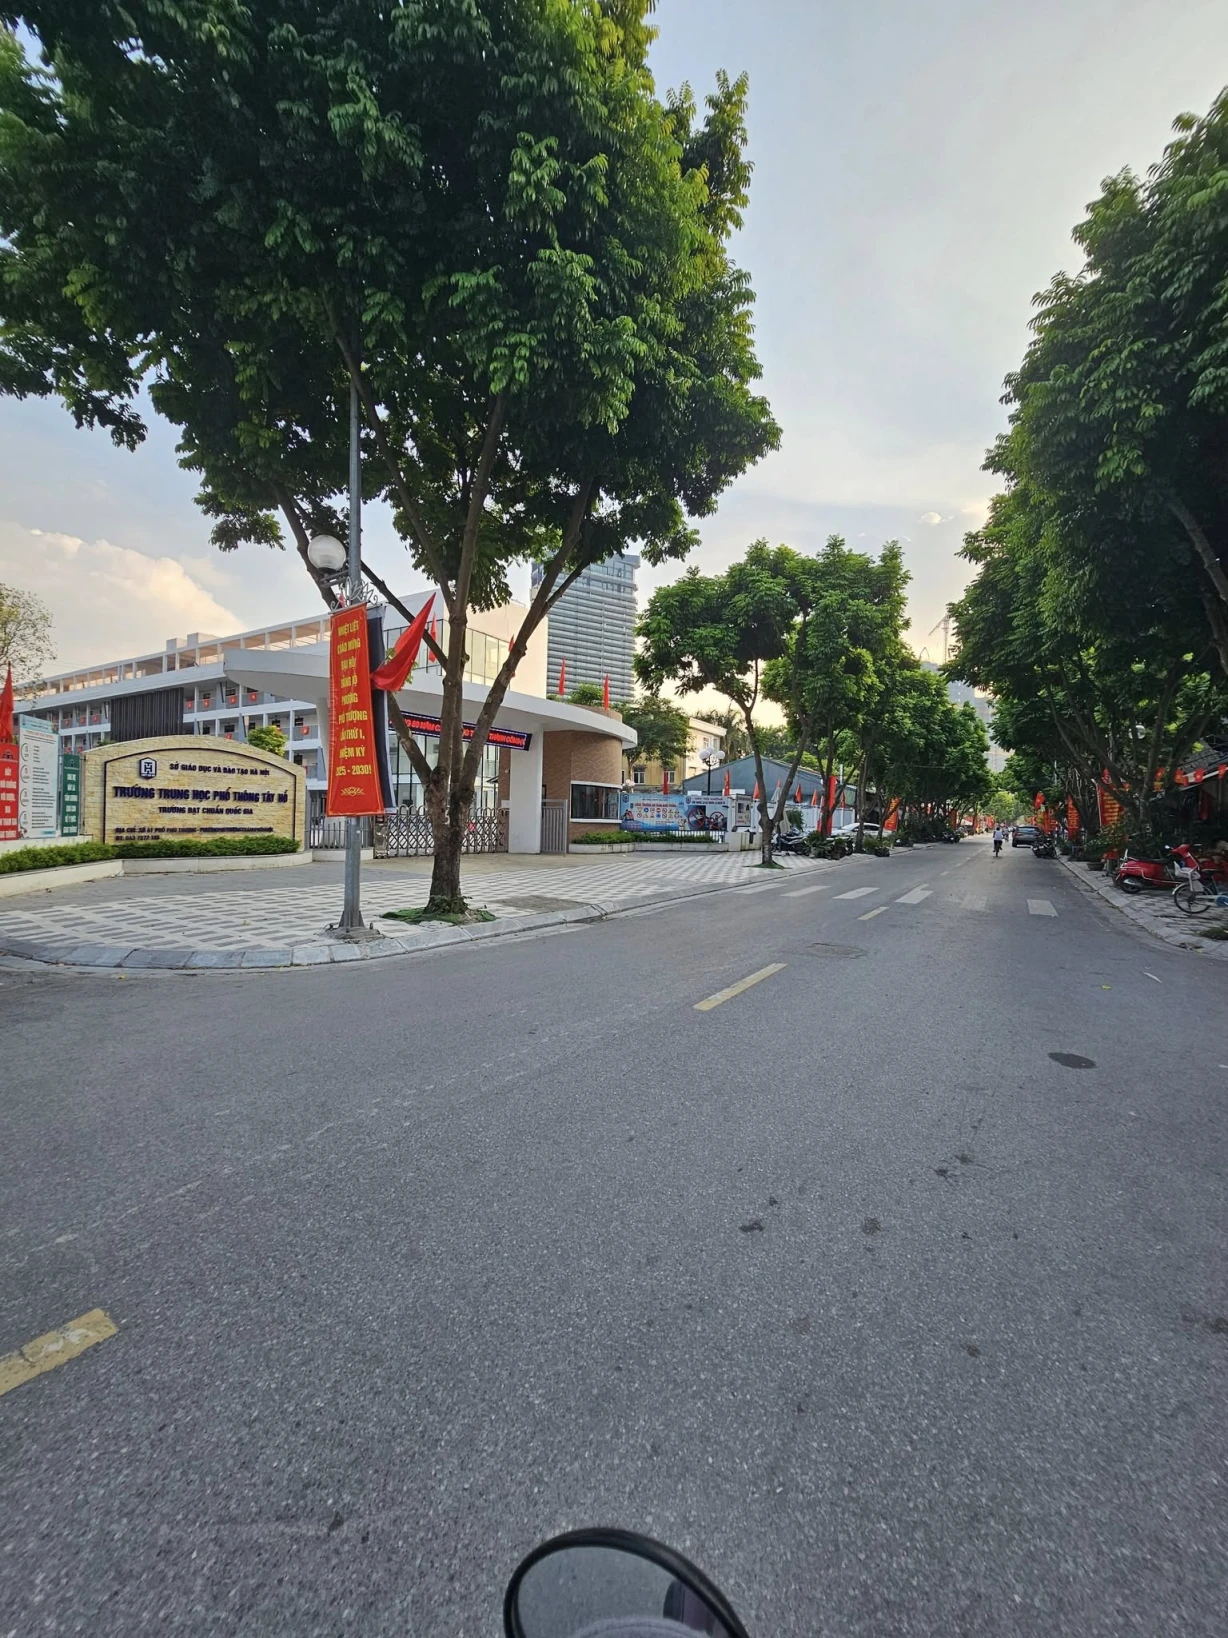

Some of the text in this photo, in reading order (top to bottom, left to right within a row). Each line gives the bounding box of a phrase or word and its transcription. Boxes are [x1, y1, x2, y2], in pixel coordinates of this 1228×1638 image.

[180, 763, 197, 771] GIÁO
[198, 765, 212, 773] DỤC
[351, 764, 372, 775] 2030!
[112, 784, 155, 799] TRƯỜNG
[157, 788, 190, 800] TRUNG
[191, 789, 211, 803] HỌC
[232, 789, 260, 803] THÔNG
[261, 790, 275, 803] TÂY
[158, 805, 186, 813] TRƯỜNG
[225, 806, 242, 815] QUỐC
